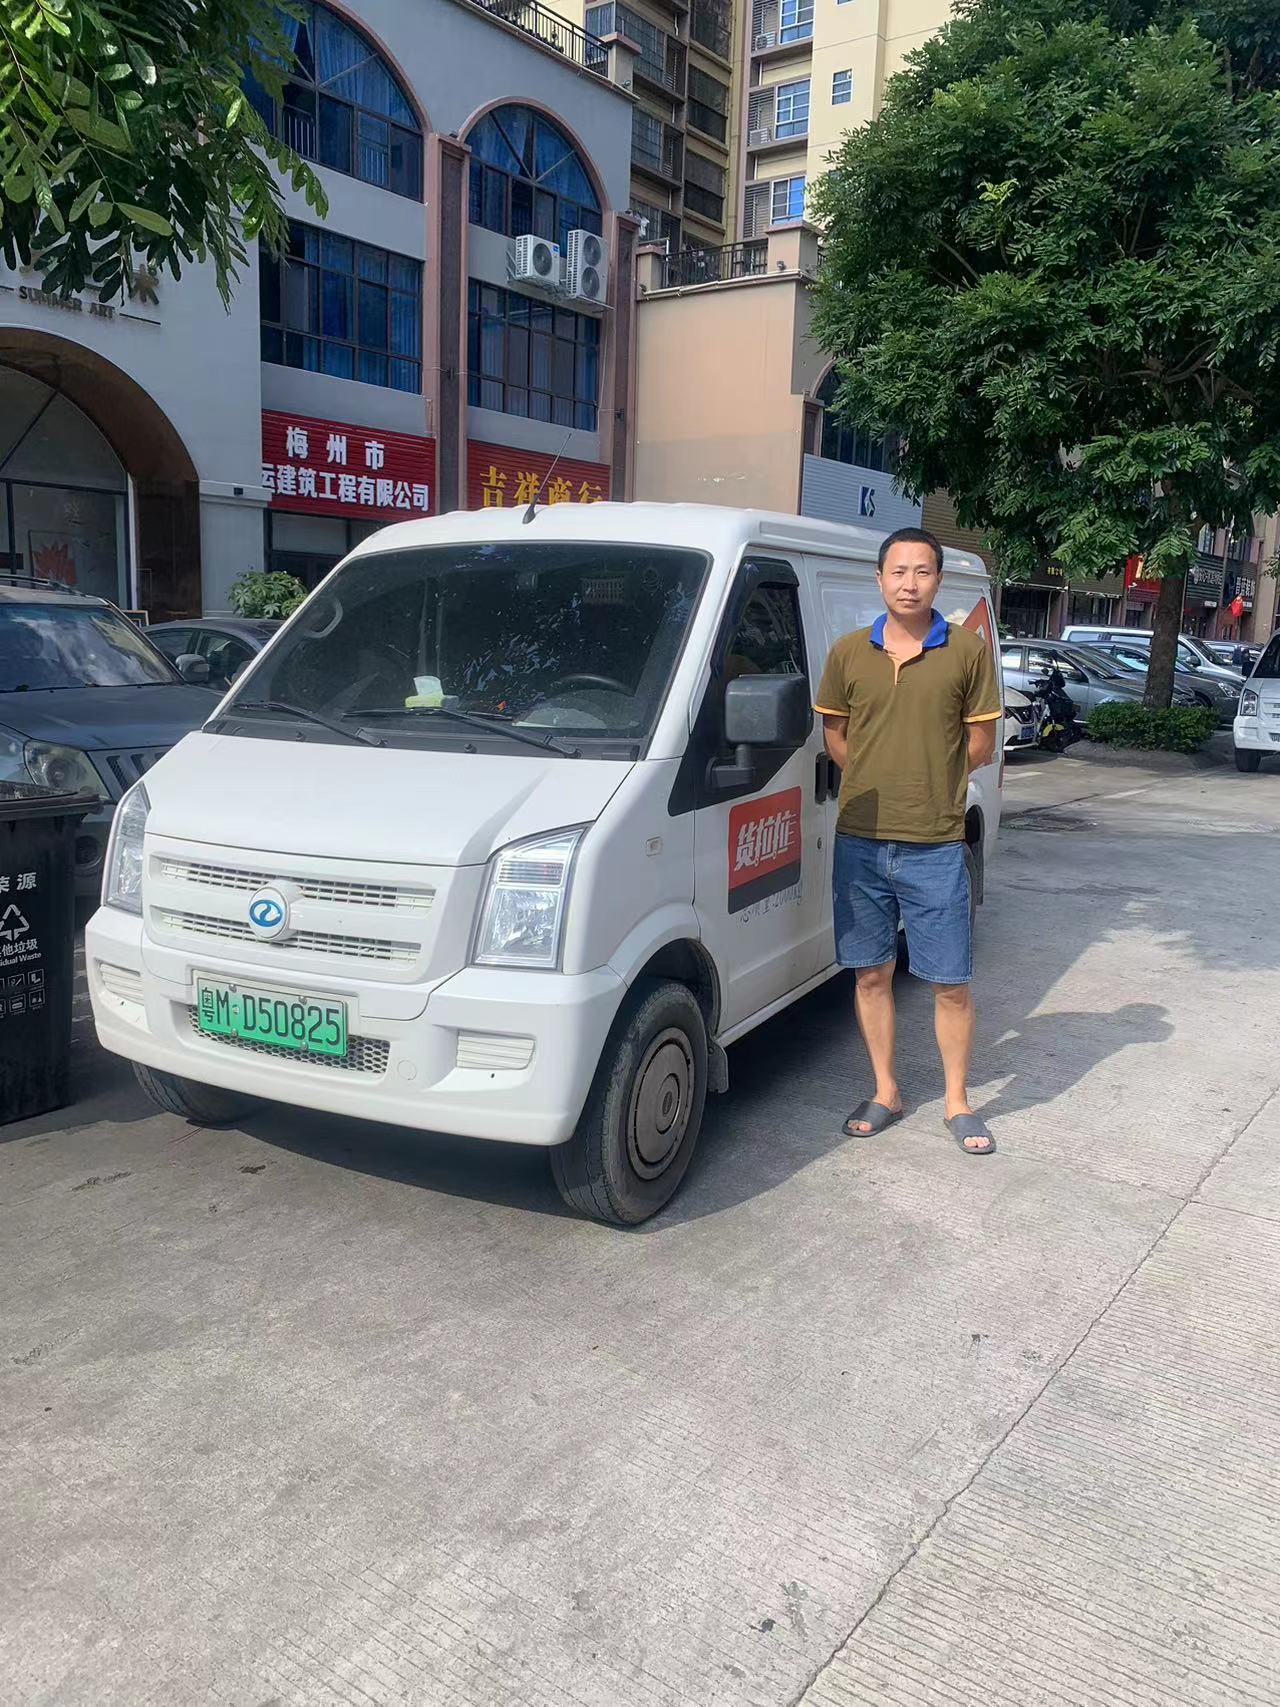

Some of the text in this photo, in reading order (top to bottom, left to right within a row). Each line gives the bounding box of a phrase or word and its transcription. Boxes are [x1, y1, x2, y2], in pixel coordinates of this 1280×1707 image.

[286, 425, 385, 470] 梅州市
[480, 465, 603, 507] 吉祥商行
[734, 810, 797, 871] 货拉拉
[0, 938, 38, 957] 他垃圾
